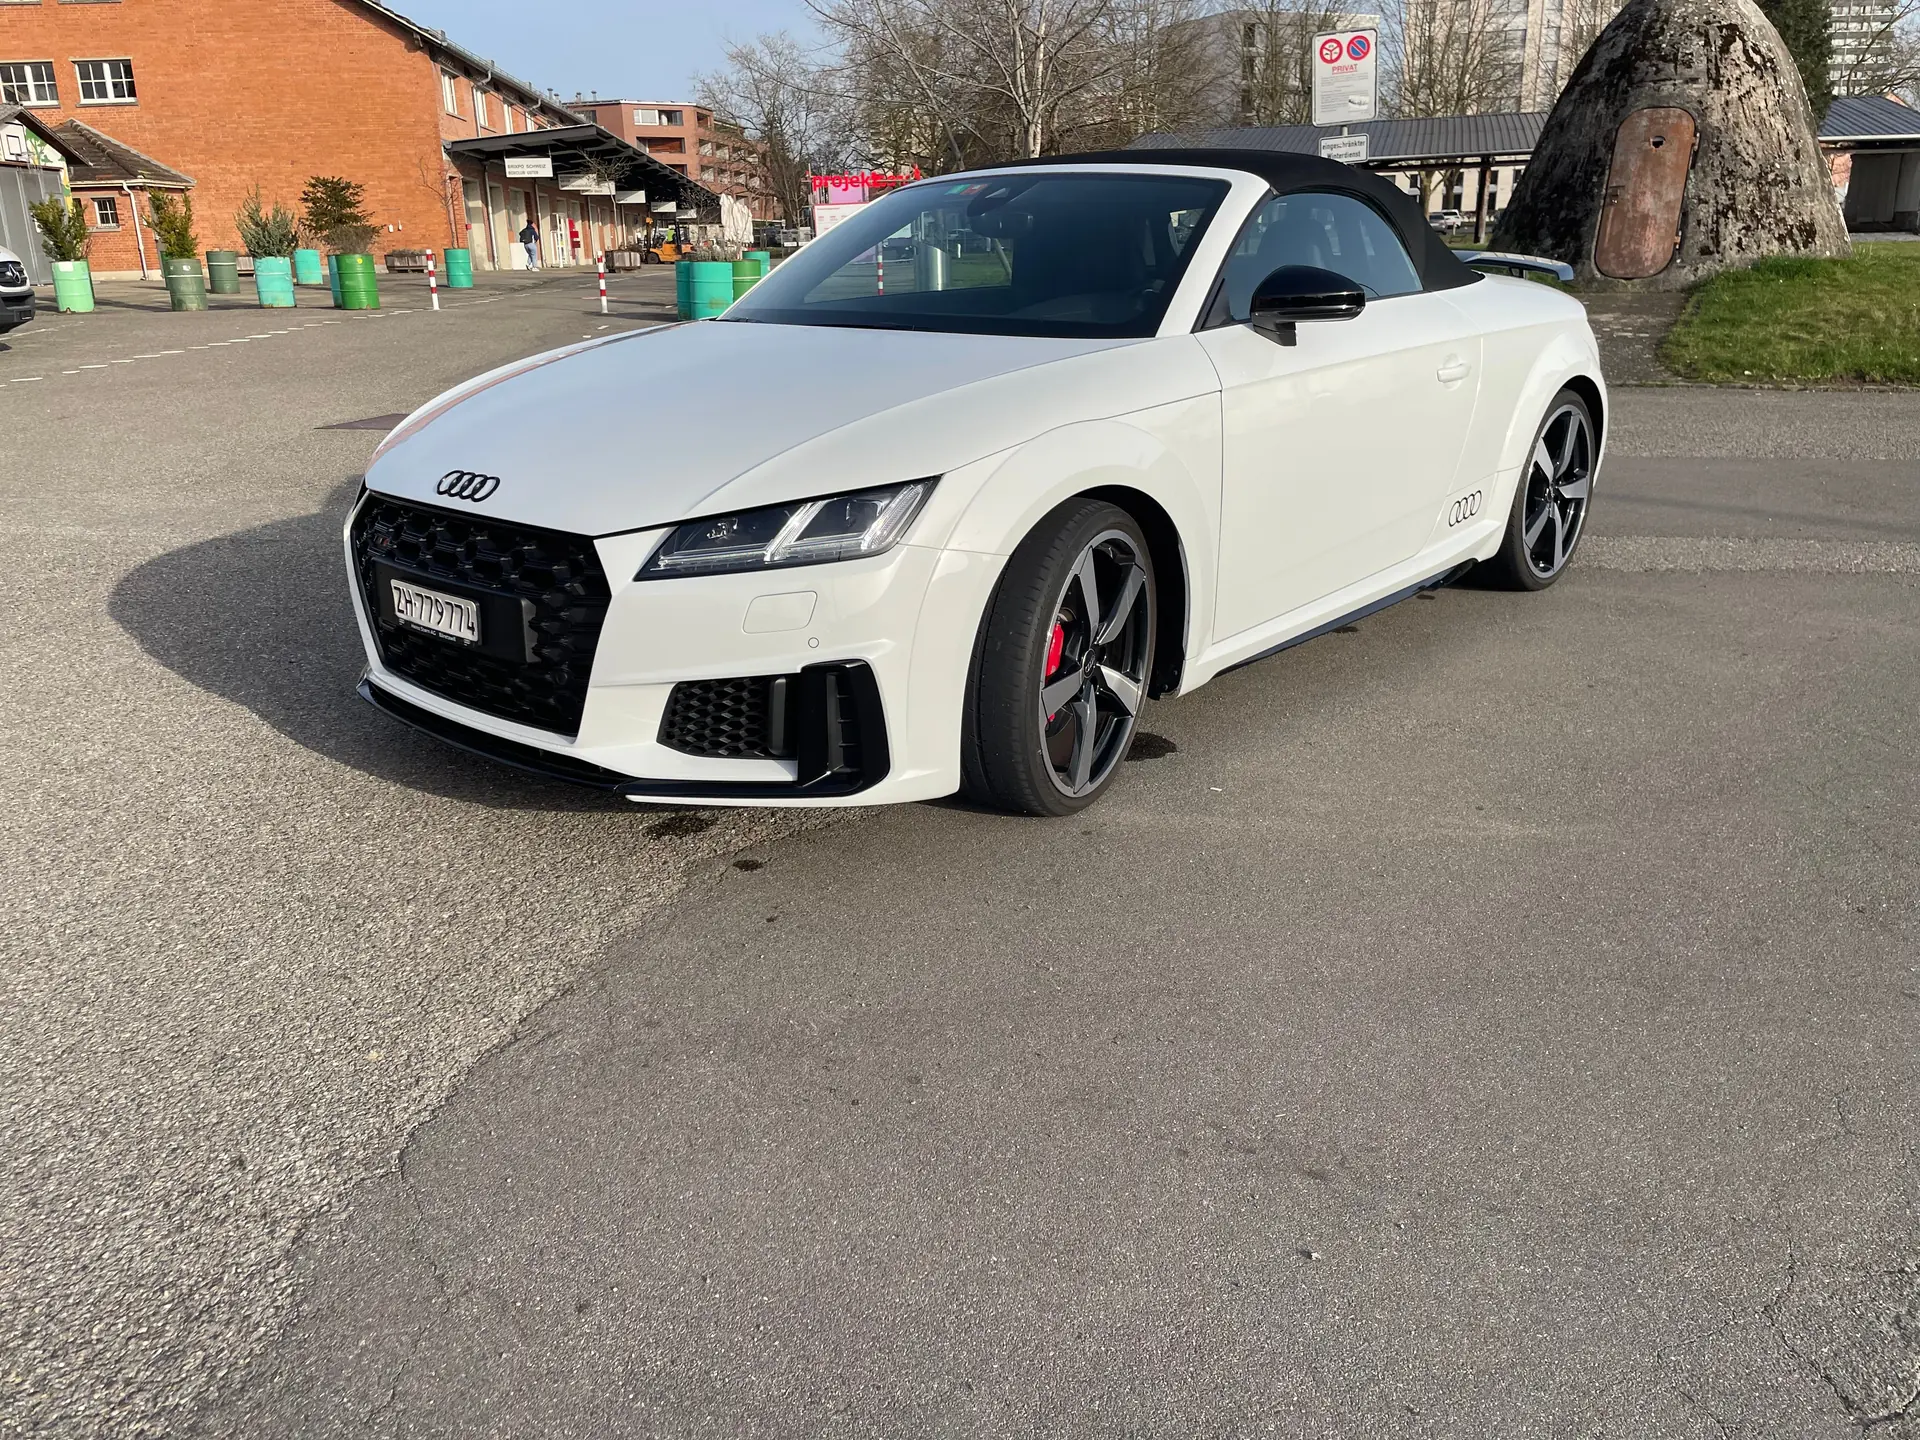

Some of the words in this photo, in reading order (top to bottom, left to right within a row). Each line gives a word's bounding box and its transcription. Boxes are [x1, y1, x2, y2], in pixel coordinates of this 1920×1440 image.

[1332, 64, 1358, 73] PRIVAT
[1322, 140, 1366, 151] eingeschränkter
[1327, 151, 1361, 159] Winterdienst
